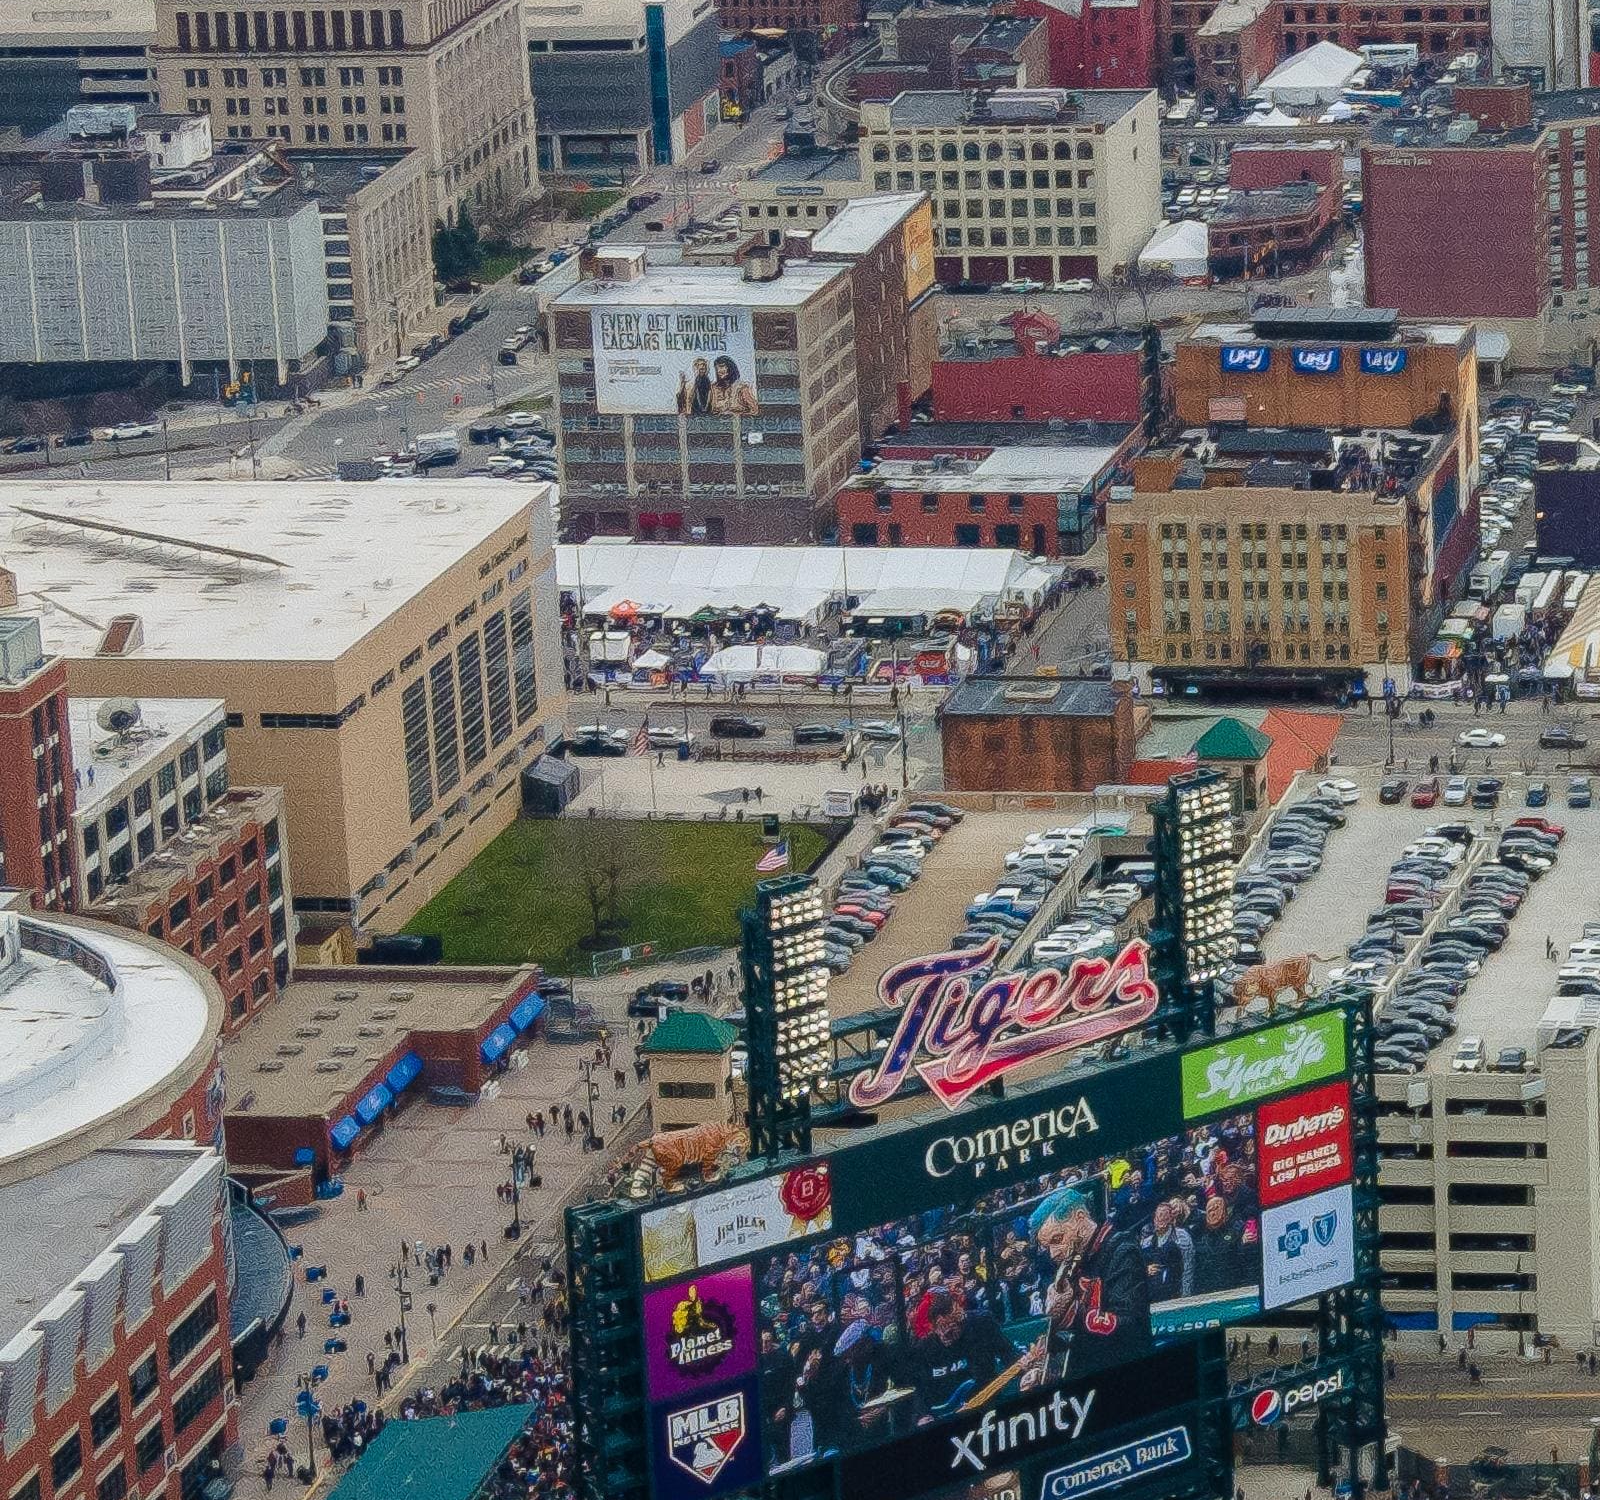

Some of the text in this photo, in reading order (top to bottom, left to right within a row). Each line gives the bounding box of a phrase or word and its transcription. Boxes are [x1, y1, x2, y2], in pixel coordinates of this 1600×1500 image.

[601, 313, 738, 332] EVERY BET BRINGETH
[602, 332, 727, 351] CAESARS REWARDS
[849, 935, 1159, 1111] Tigers
[1264, 1105, 1345, 1147] Dunham's
[975, 1141, 1054, 1179] PARK
[670, 1328, 721, 1360] planet
[678, 1339, 733, 1365] fitness
[1284, 1368, 1343, 1412] pepsi
[673, 1398, 740, 1438] MLB
[951, 1389, 1095, 1471] xfinity
[1135, 1436, 1179, 1466] Bank
